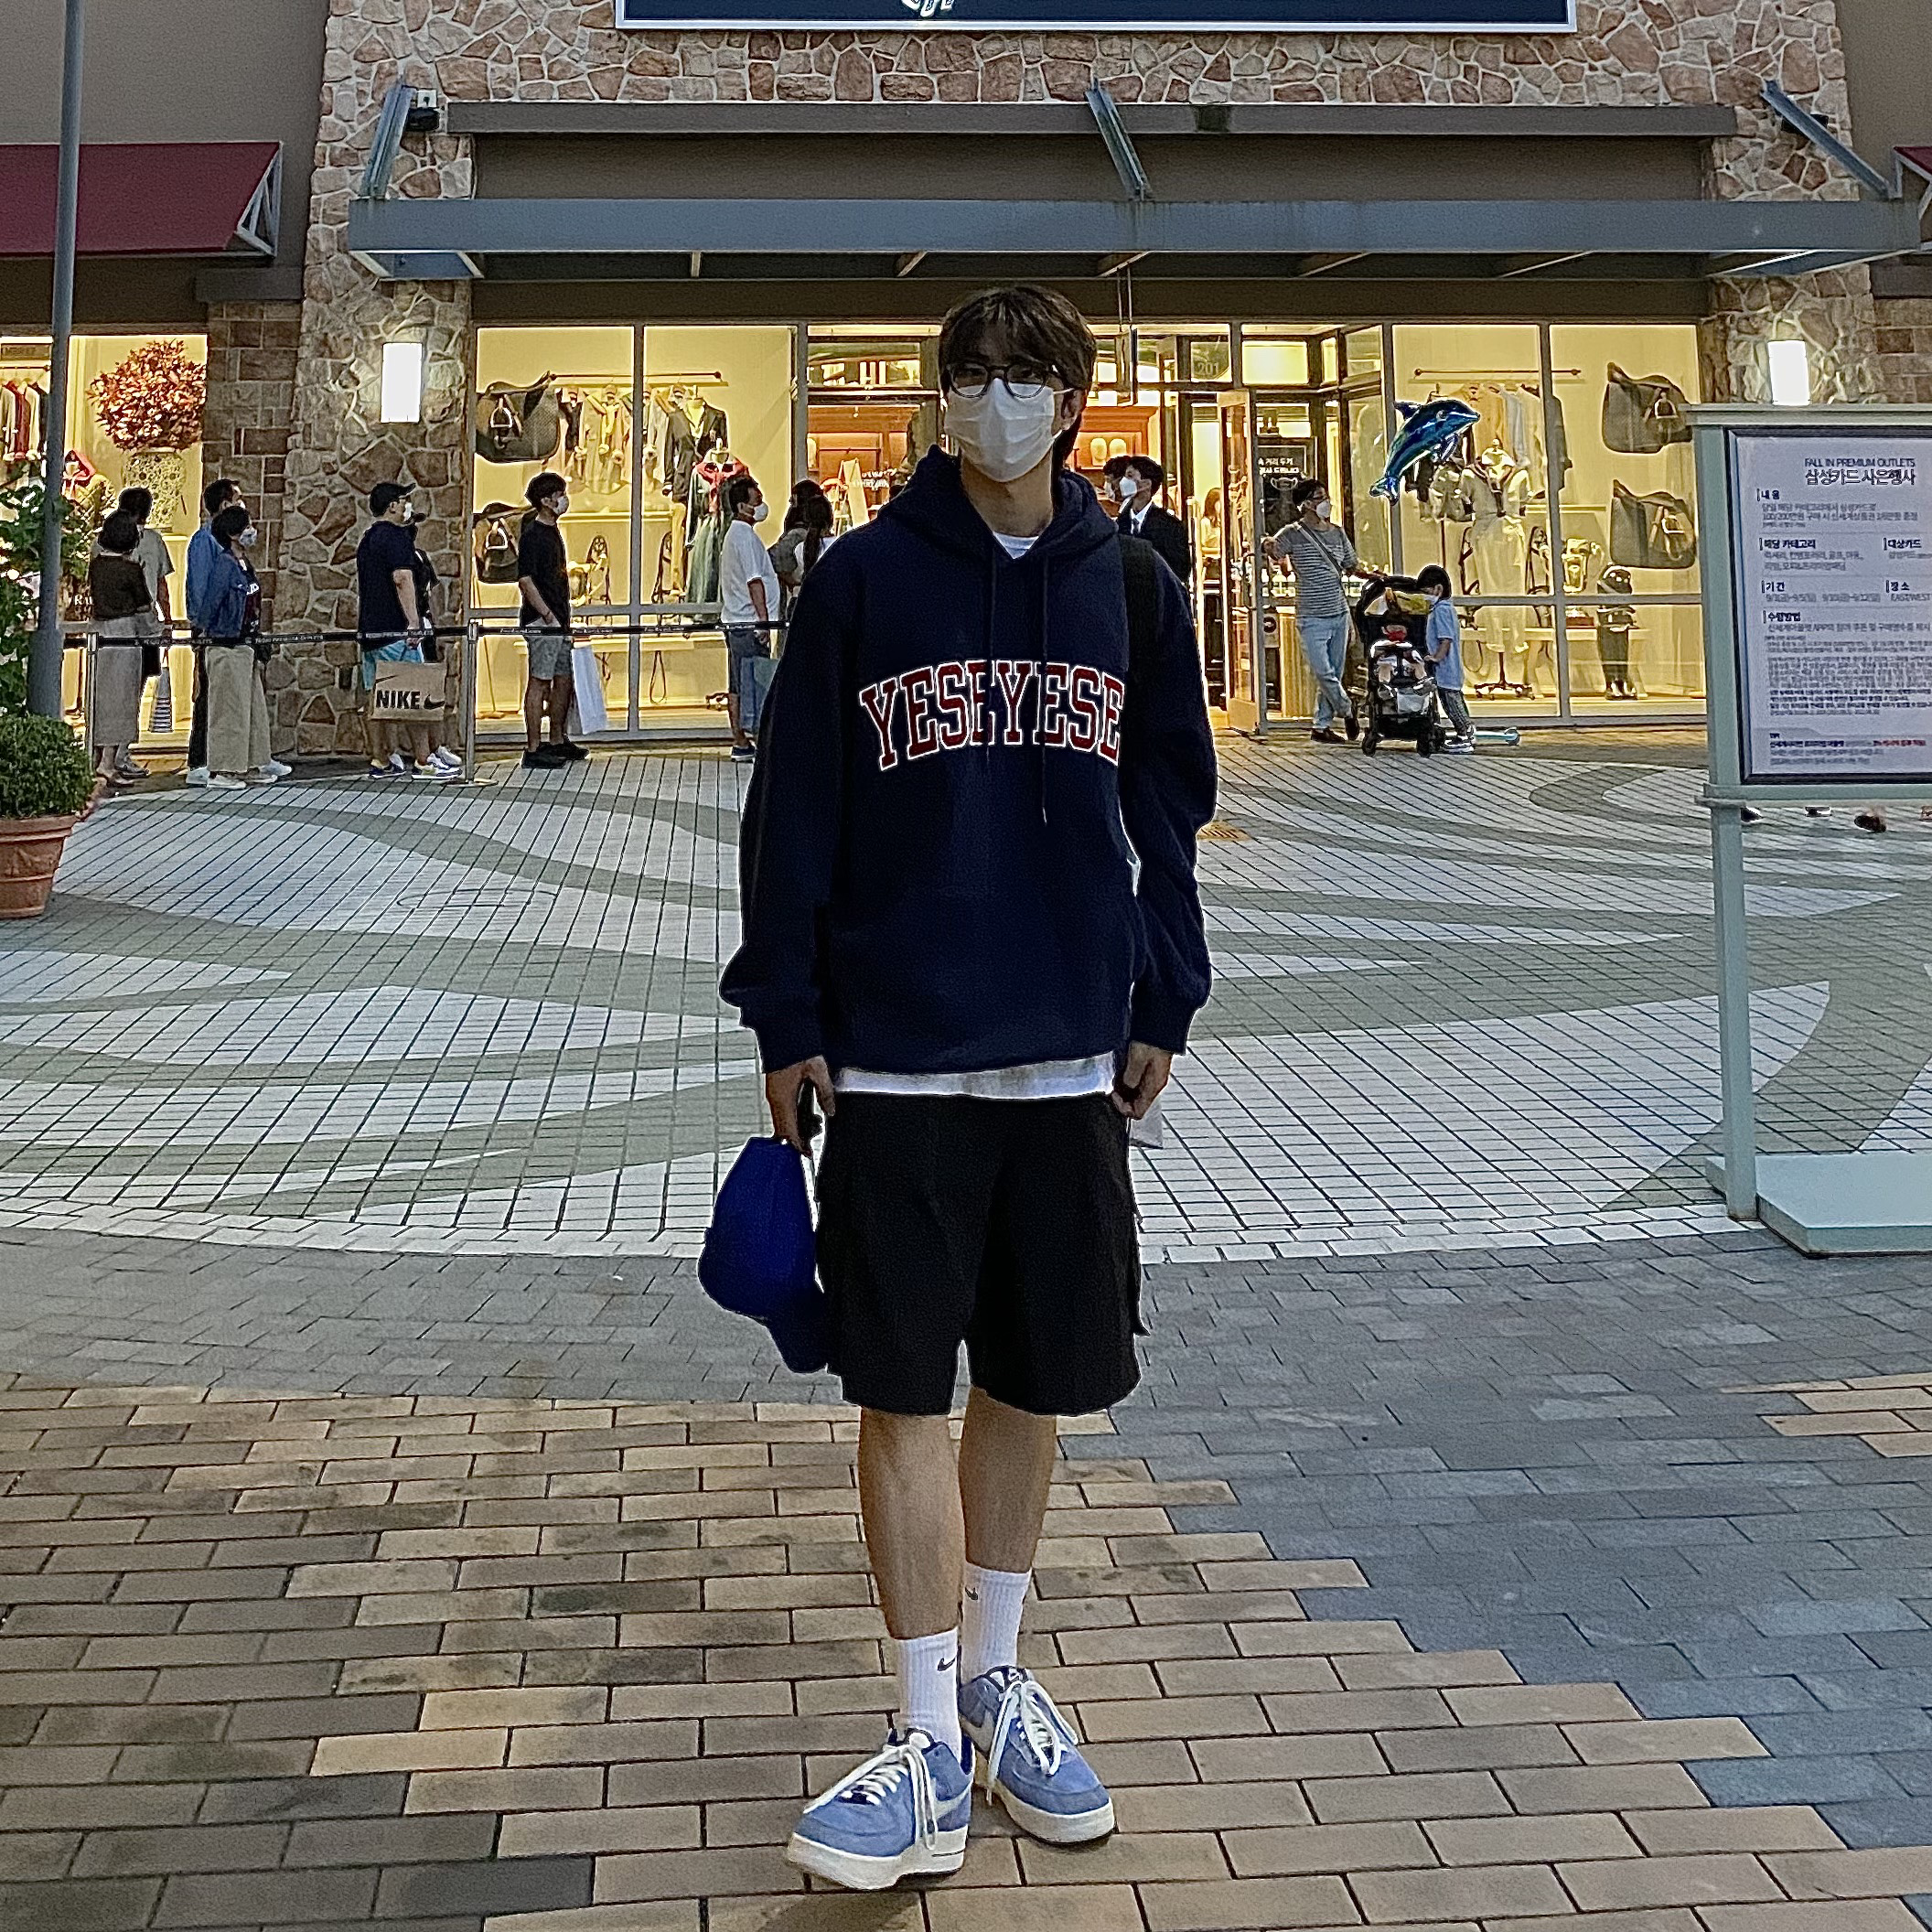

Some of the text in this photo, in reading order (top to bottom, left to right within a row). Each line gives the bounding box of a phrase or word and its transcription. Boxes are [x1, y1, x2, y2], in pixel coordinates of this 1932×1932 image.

[1197, 361, 1219, 376] 201
[1805, 458, 1916, 467] FALL IN PREMIUM OUTLETS
[1805, 468, 1916, 486] 삼성카드 사은행사
[1783, 539, 1817, 549] 카테고리
[1887, 539, 1923, 549] 대상카드
[375, 690, 421, 710] NIKE
[858, 659, 1126, 772] YESEYESE
